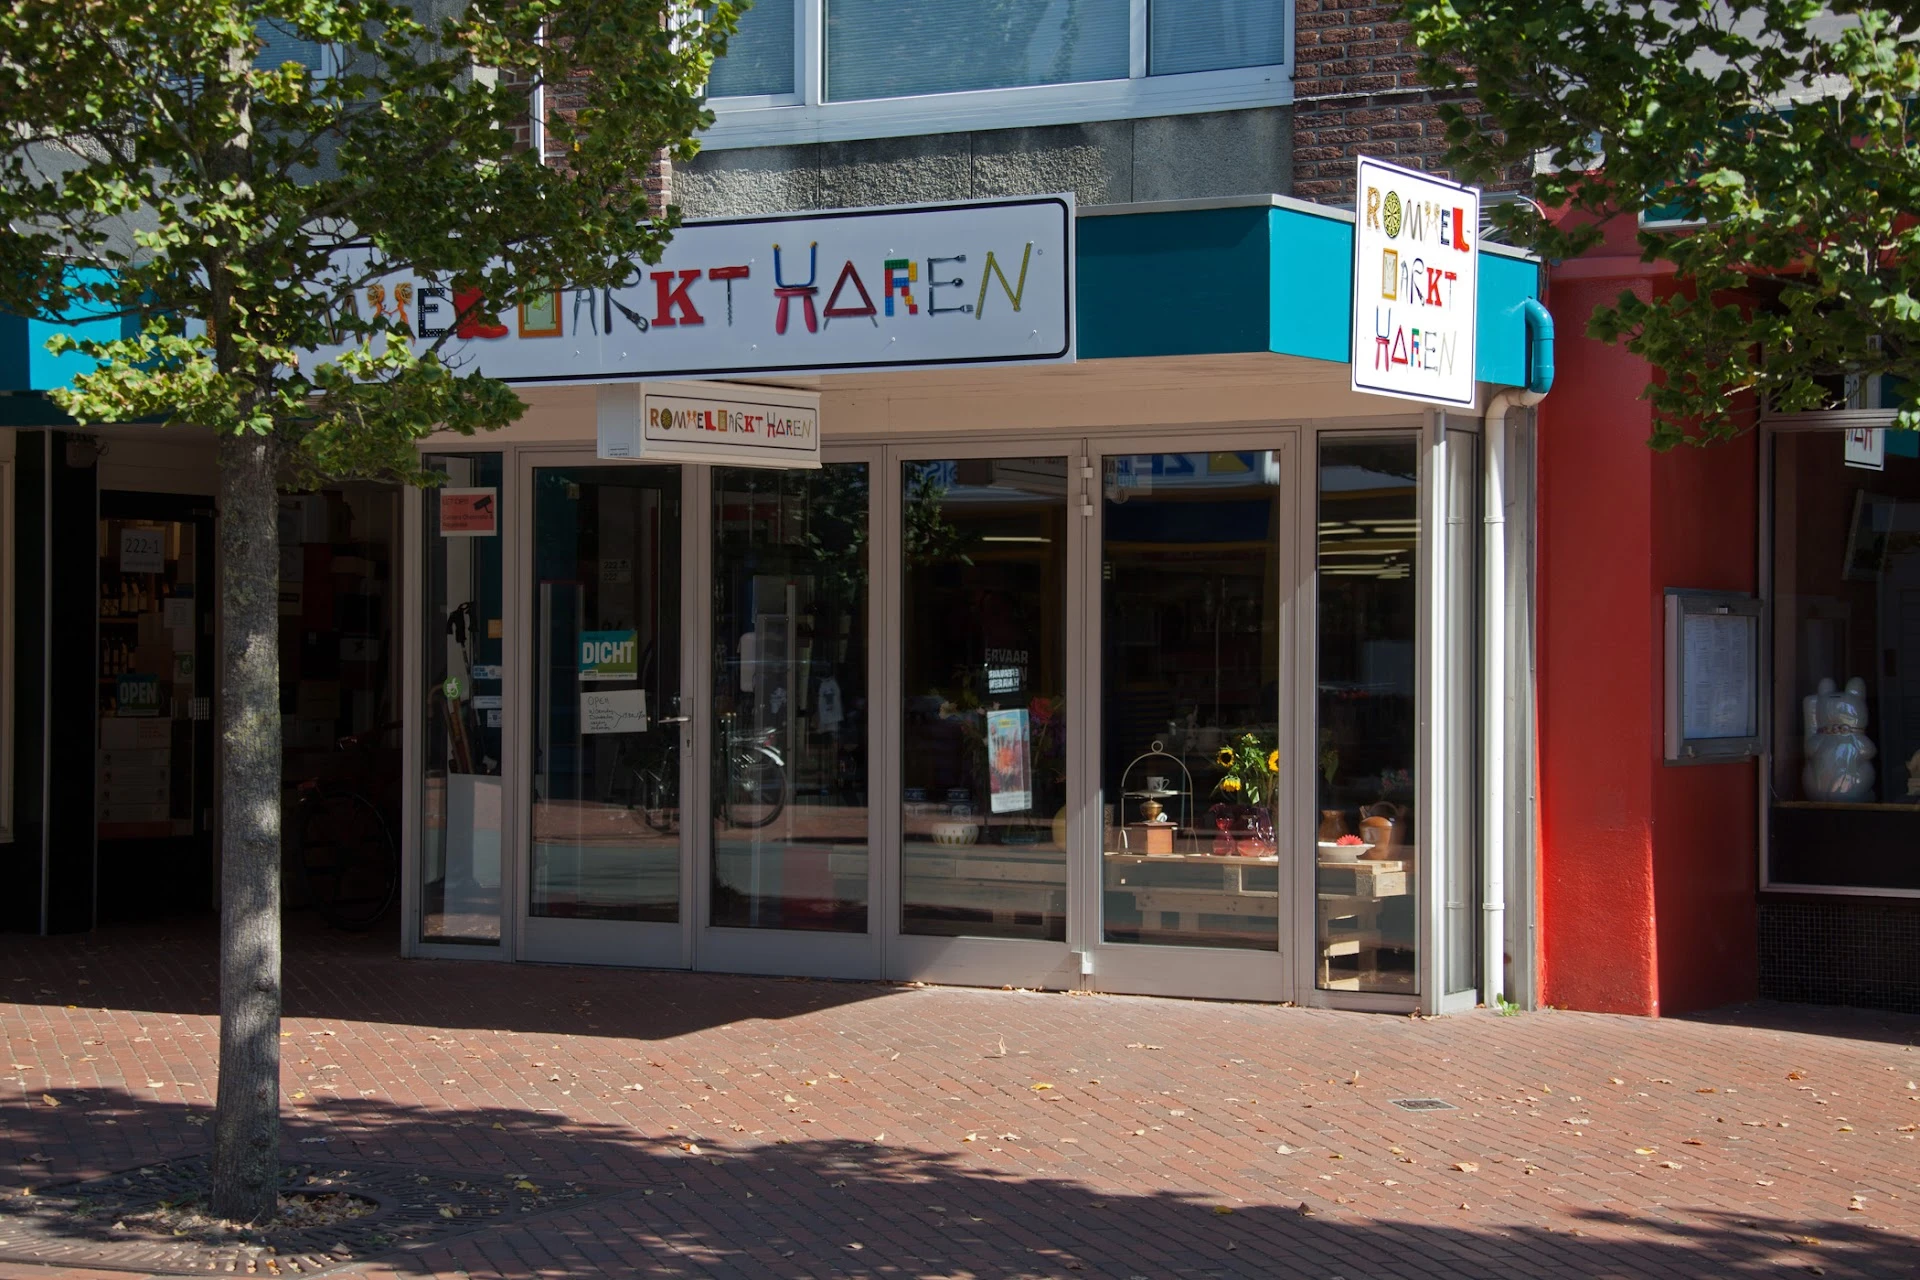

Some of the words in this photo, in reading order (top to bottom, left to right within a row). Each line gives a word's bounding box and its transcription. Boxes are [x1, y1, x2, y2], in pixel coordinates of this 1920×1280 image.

[772, 241, 1032, 335] HAREN
[1381, 247, 1457, 309] MARKT
[1375, 304, 1457, 376] HAREN
[650, 407, 764, 434] ROMMELMARKT
[766, 411, 813, 439] HAREN
[124, 537, 160, 554] 222-1
[582, 641, 634, 664] DICHT
[119, 682, 157, 705] OPEN
